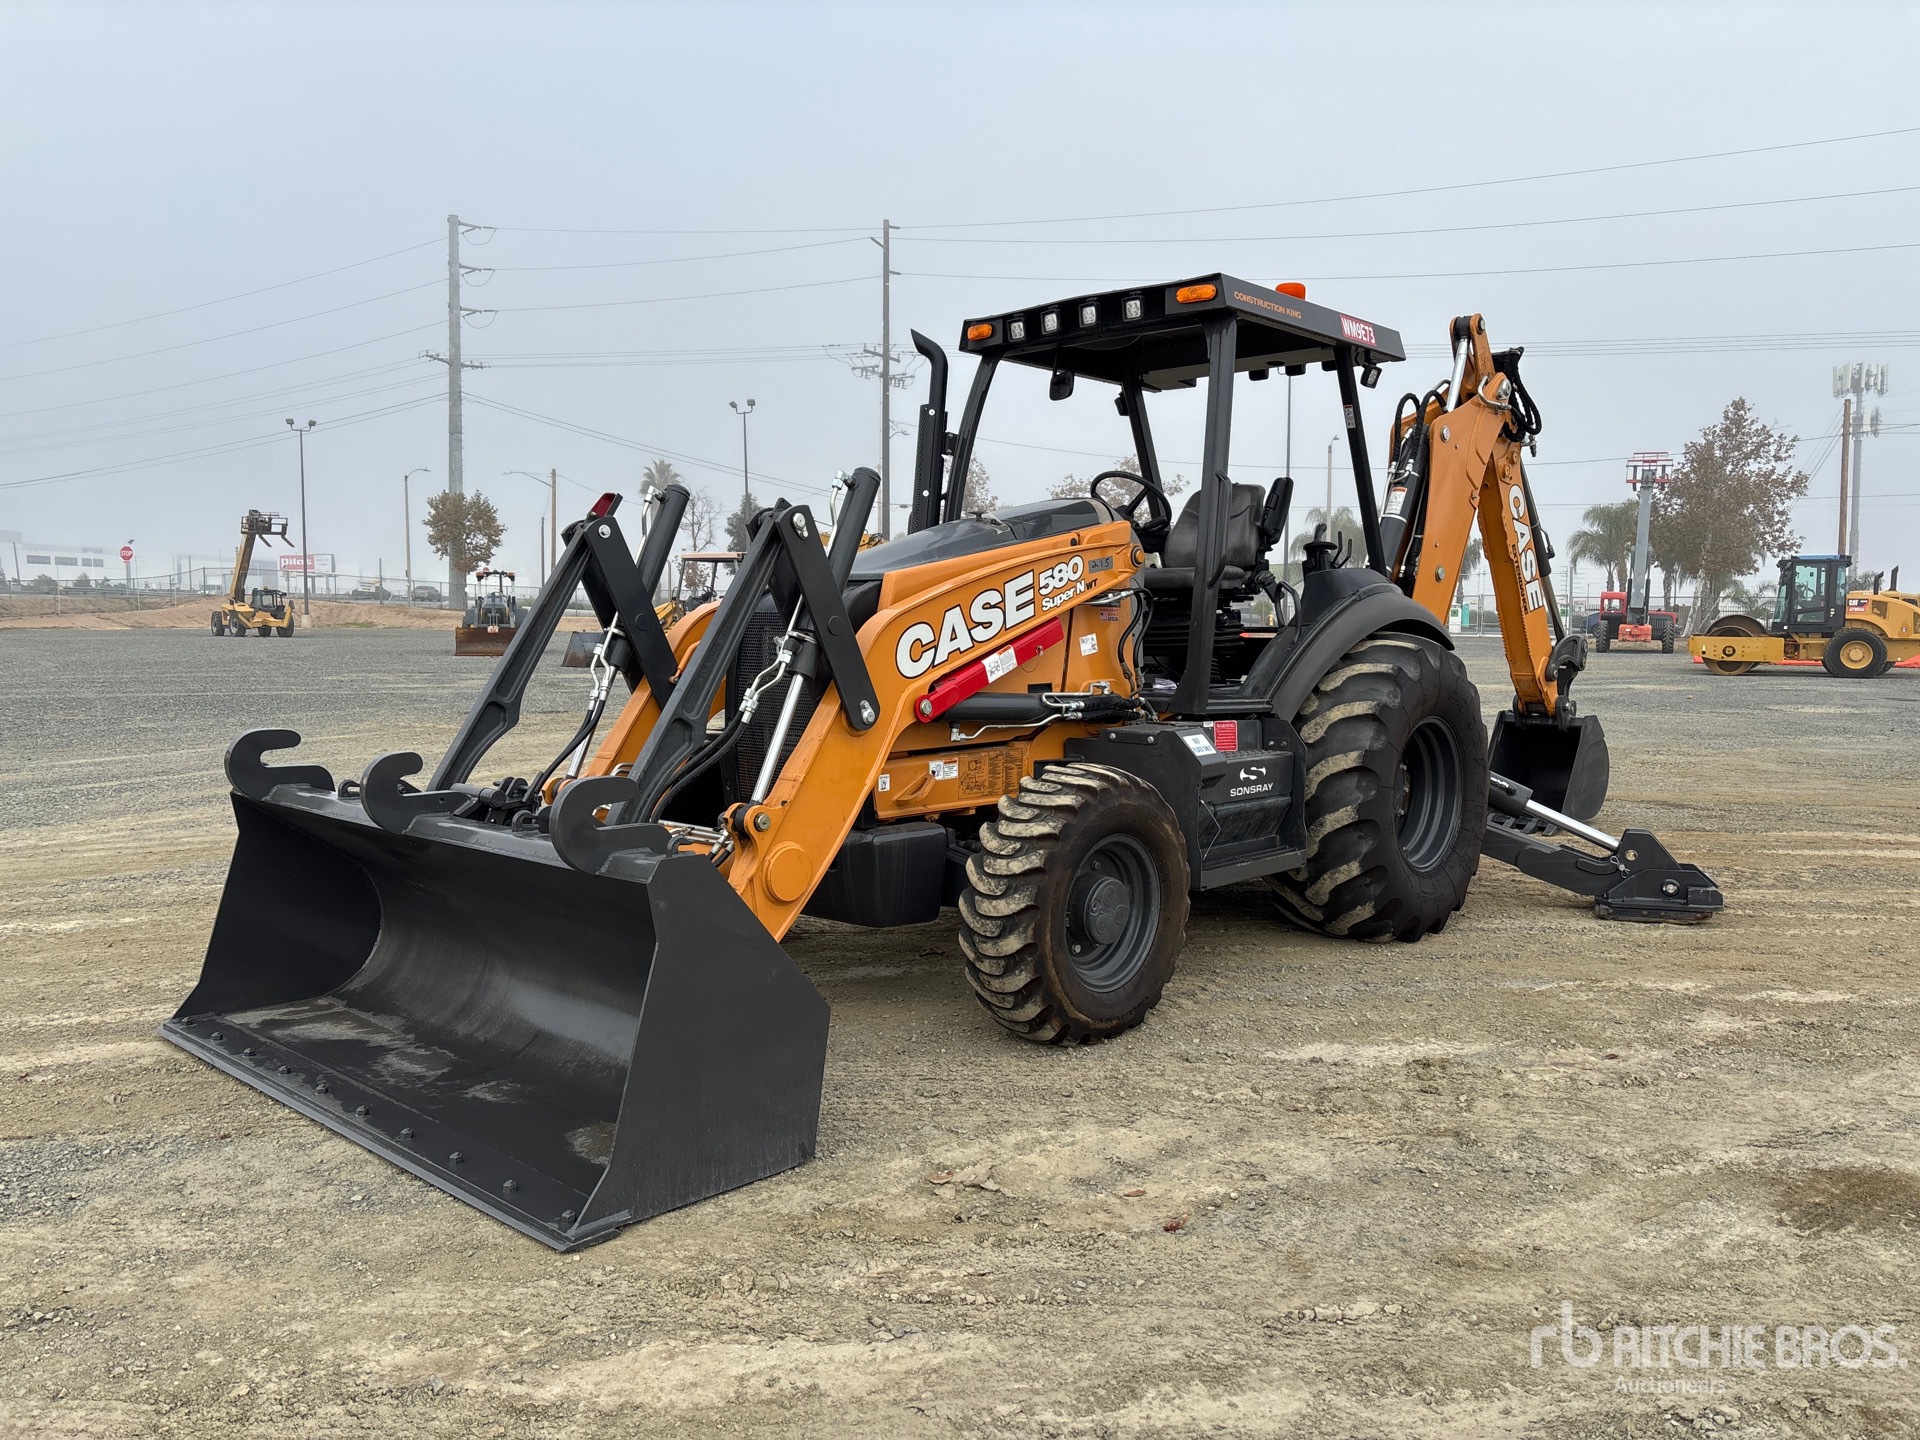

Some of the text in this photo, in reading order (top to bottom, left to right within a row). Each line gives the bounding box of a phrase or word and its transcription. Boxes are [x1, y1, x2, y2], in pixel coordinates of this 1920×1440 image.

[1233, 291, 1302, 320] CONSTRUCTION KING
[1341, 317, 1376, 344] WM9E73
[1091, 557, 1111, 569] 215
[1508, 484, 1545, 613] CASE
[1038, 554, 1085, 597] 580
[1041, 578, 1098, 612] Super N WT
[895, 568, 1036, 680] CASE
[1230, 783, 1274, 797] SONSRAY
